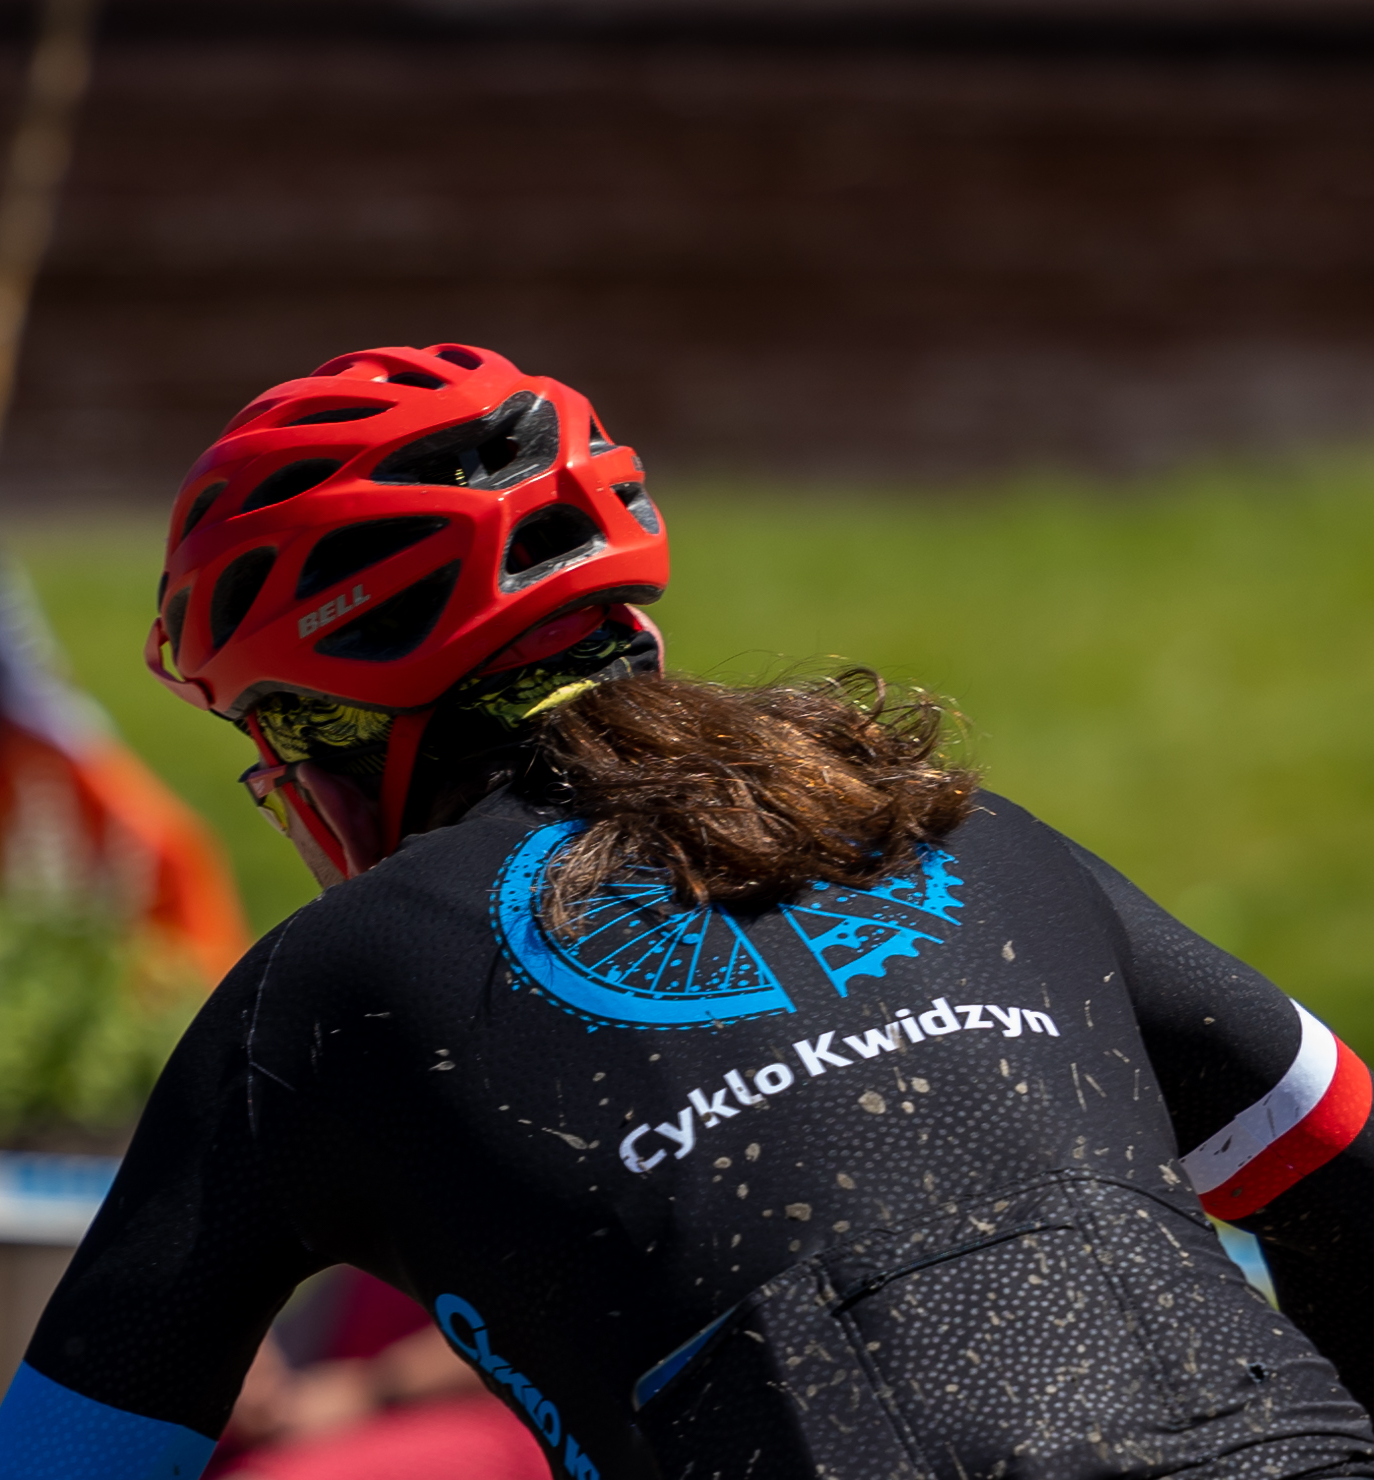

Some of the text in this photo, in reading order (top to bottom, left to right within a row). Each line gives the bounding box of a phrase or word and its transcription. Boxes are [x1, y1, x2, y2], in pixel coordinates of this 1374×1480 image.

[298, 583, 372, 639] BELL
[618, 996, 1061, 1174] Cyklo Kwidzyn
